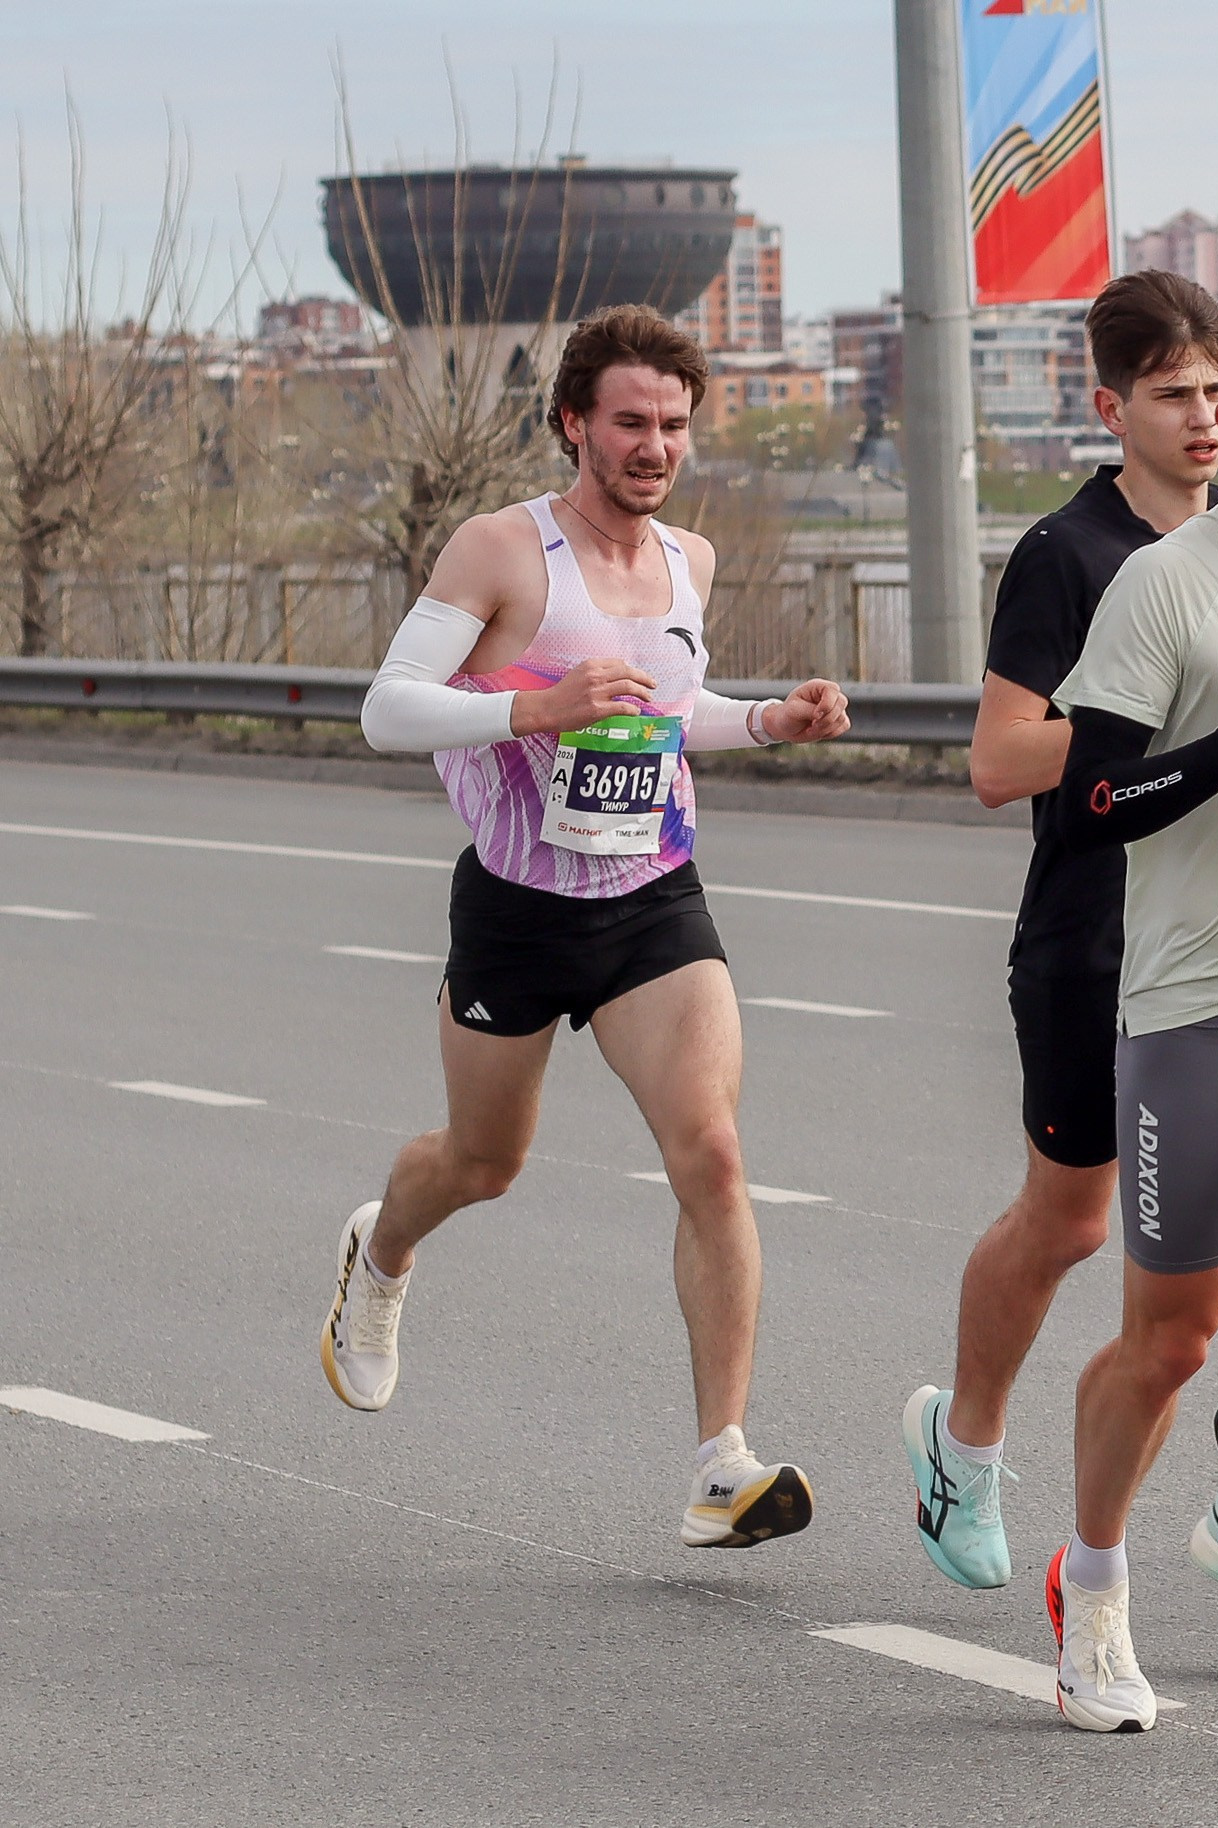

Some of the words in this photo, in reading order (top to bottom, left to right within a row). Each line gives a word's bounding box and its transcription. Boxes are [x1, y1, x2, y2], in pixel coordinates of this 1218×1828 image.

[580, 764, 655, 800] 36915
[1112, 770, 1183, 802] COROS
[600, 800, 630, 812] ТИМУР
[568, 826, 603, 837] МАГНИТ
[1138, 1102, 1162, 1241] ADIXION
